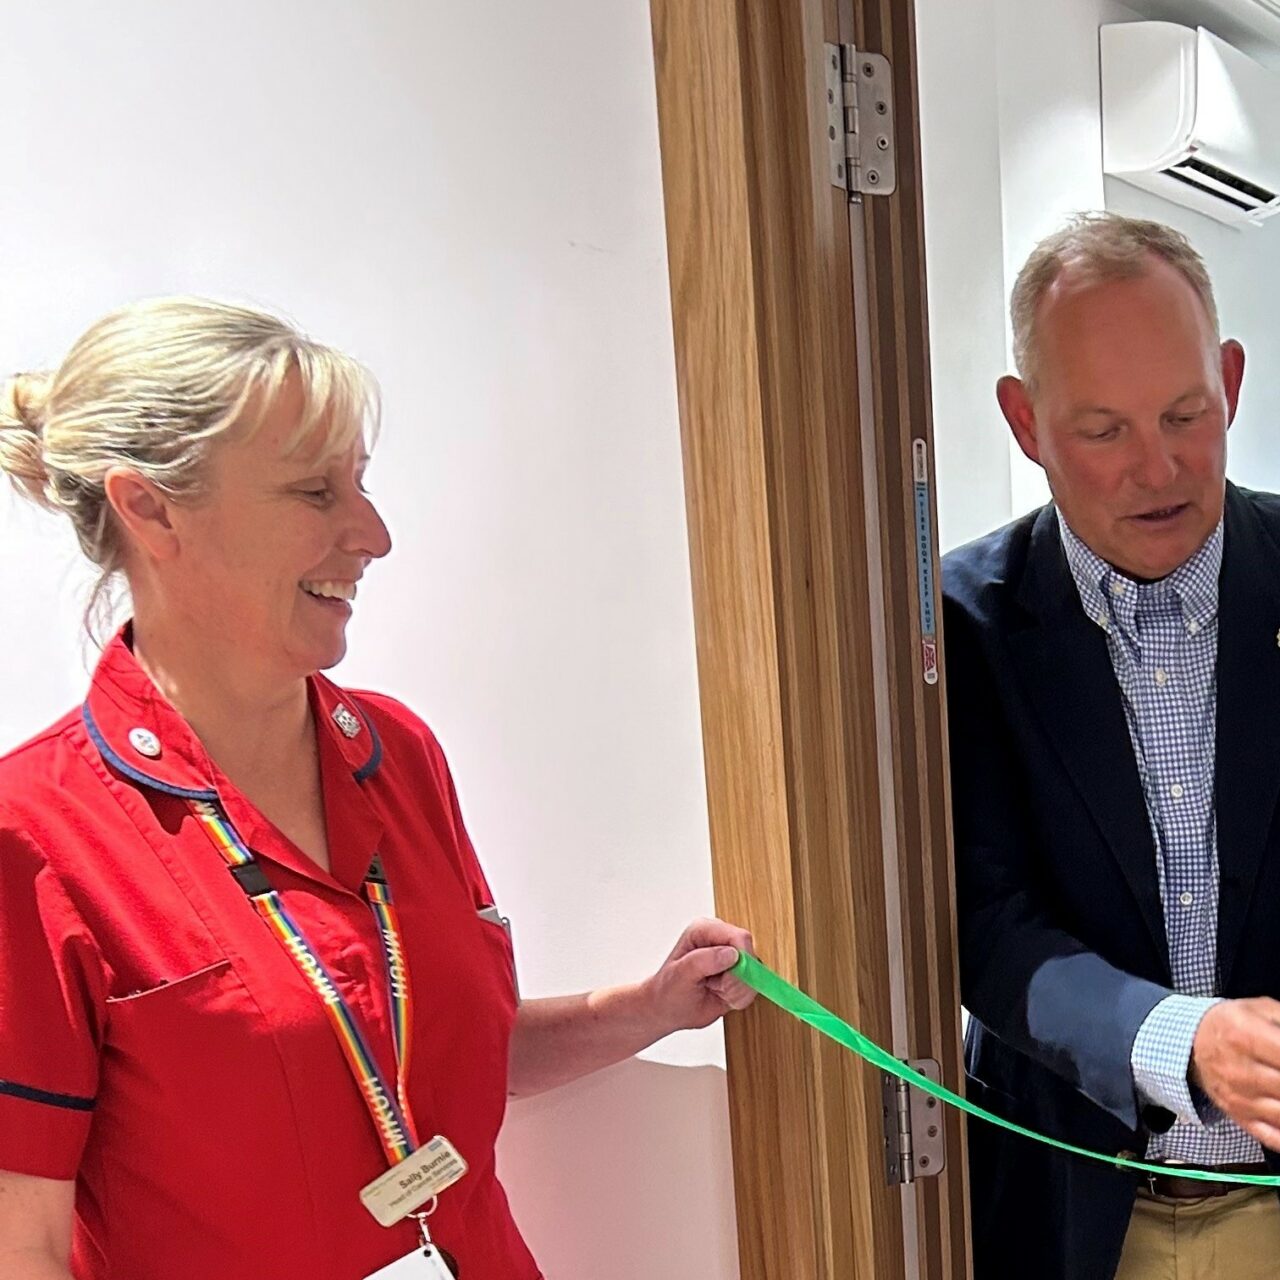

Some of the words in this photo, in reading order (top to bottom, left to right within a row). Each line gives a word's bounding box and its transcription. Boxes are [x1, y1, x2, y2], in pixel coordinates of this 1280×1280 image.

[284, 936, 340, 1005] MKUH
[382, 928, 409, 1000] MKUH
[363, 1076, 407, 1149] MKUH
[398, 1171, 422, 1189] Sally
[420, 1151, 451, 1174] Burnie
